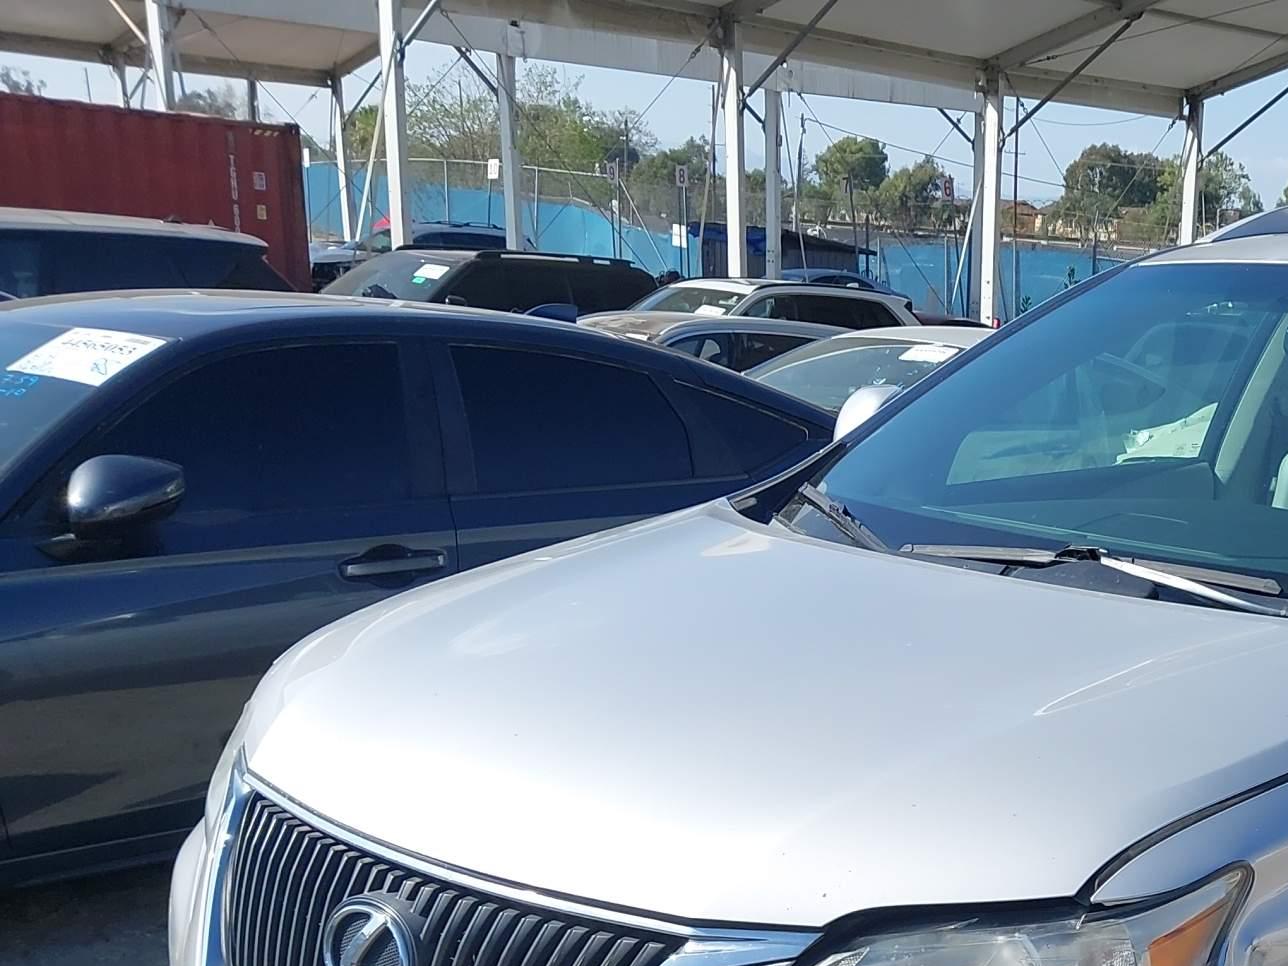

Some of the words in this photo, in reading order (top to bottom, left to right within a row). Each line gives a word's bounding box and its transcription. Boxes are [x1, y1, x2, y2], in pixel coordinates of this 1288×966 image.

[608, 166, 615, 181] 9
[678, 169, 686, 183] 8
[943, 180, 952, 197] 6
